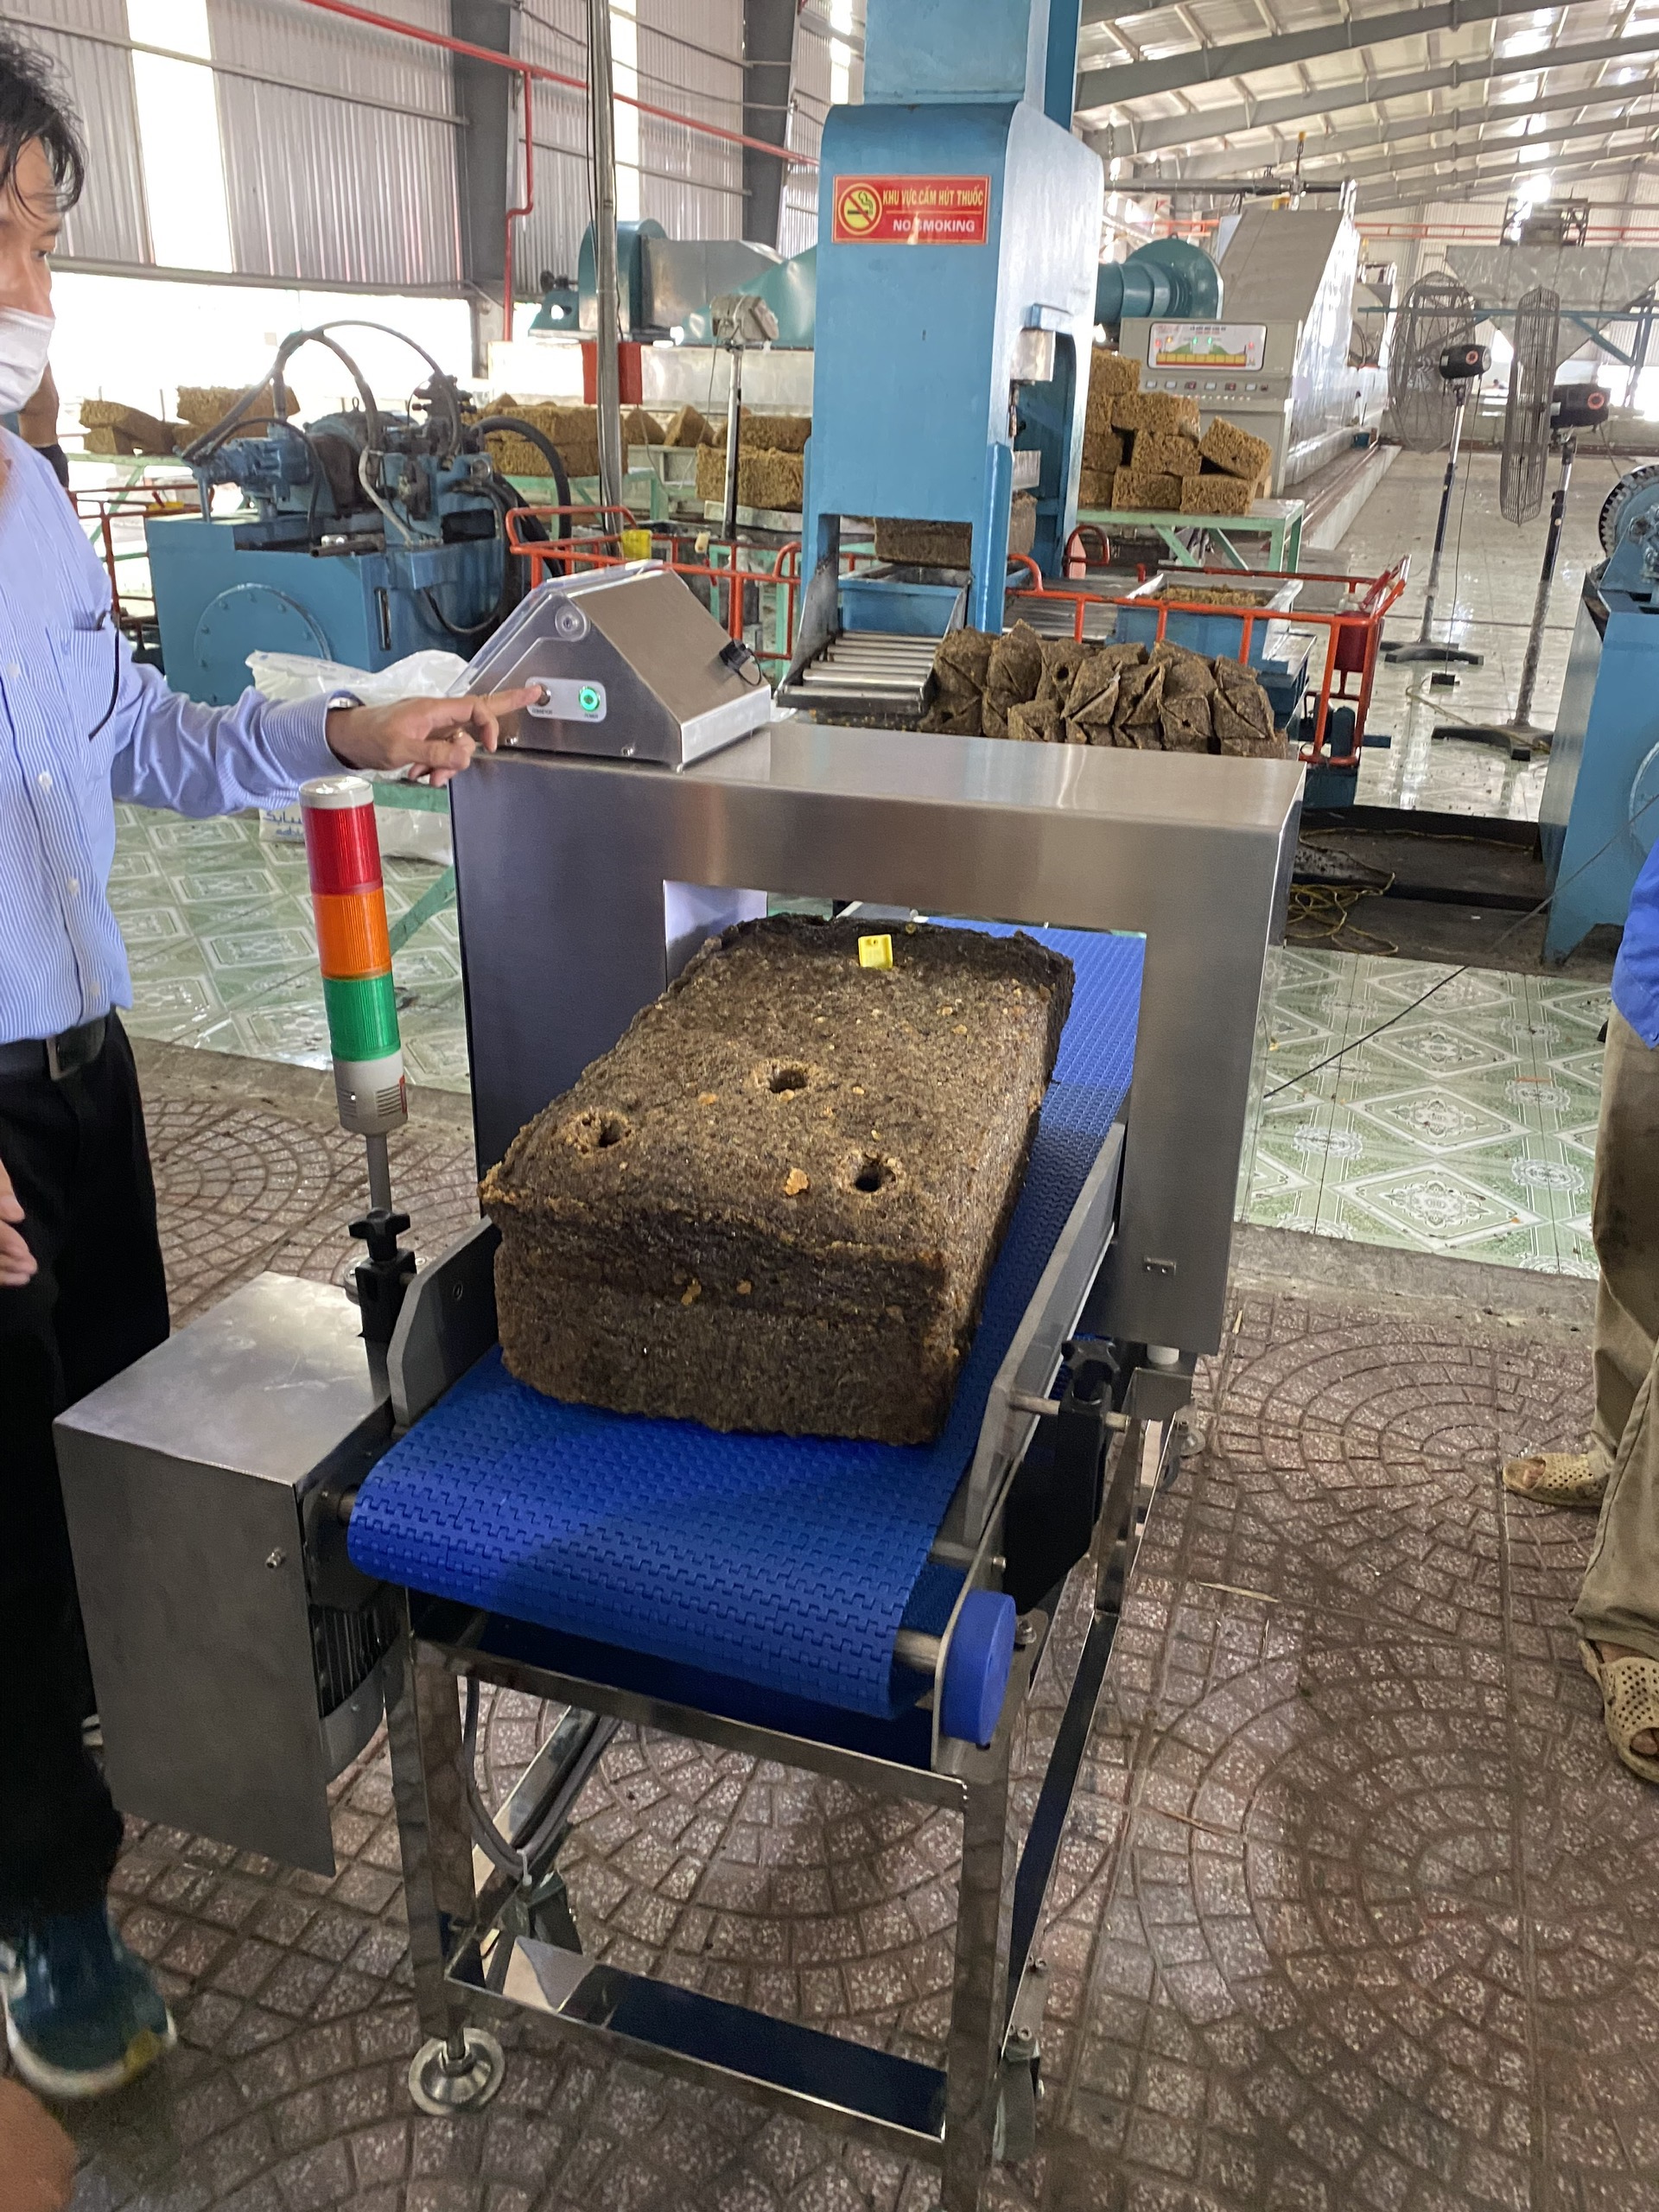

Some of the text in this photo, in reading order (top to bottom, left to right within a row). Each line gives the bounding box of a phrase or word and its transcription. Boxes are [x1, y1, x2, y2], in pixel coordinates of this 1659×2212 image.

[882, 184, 983, 208] KHU VỰC CẤM HÚT THUỐC
[893, 219, 912, 232] NO
